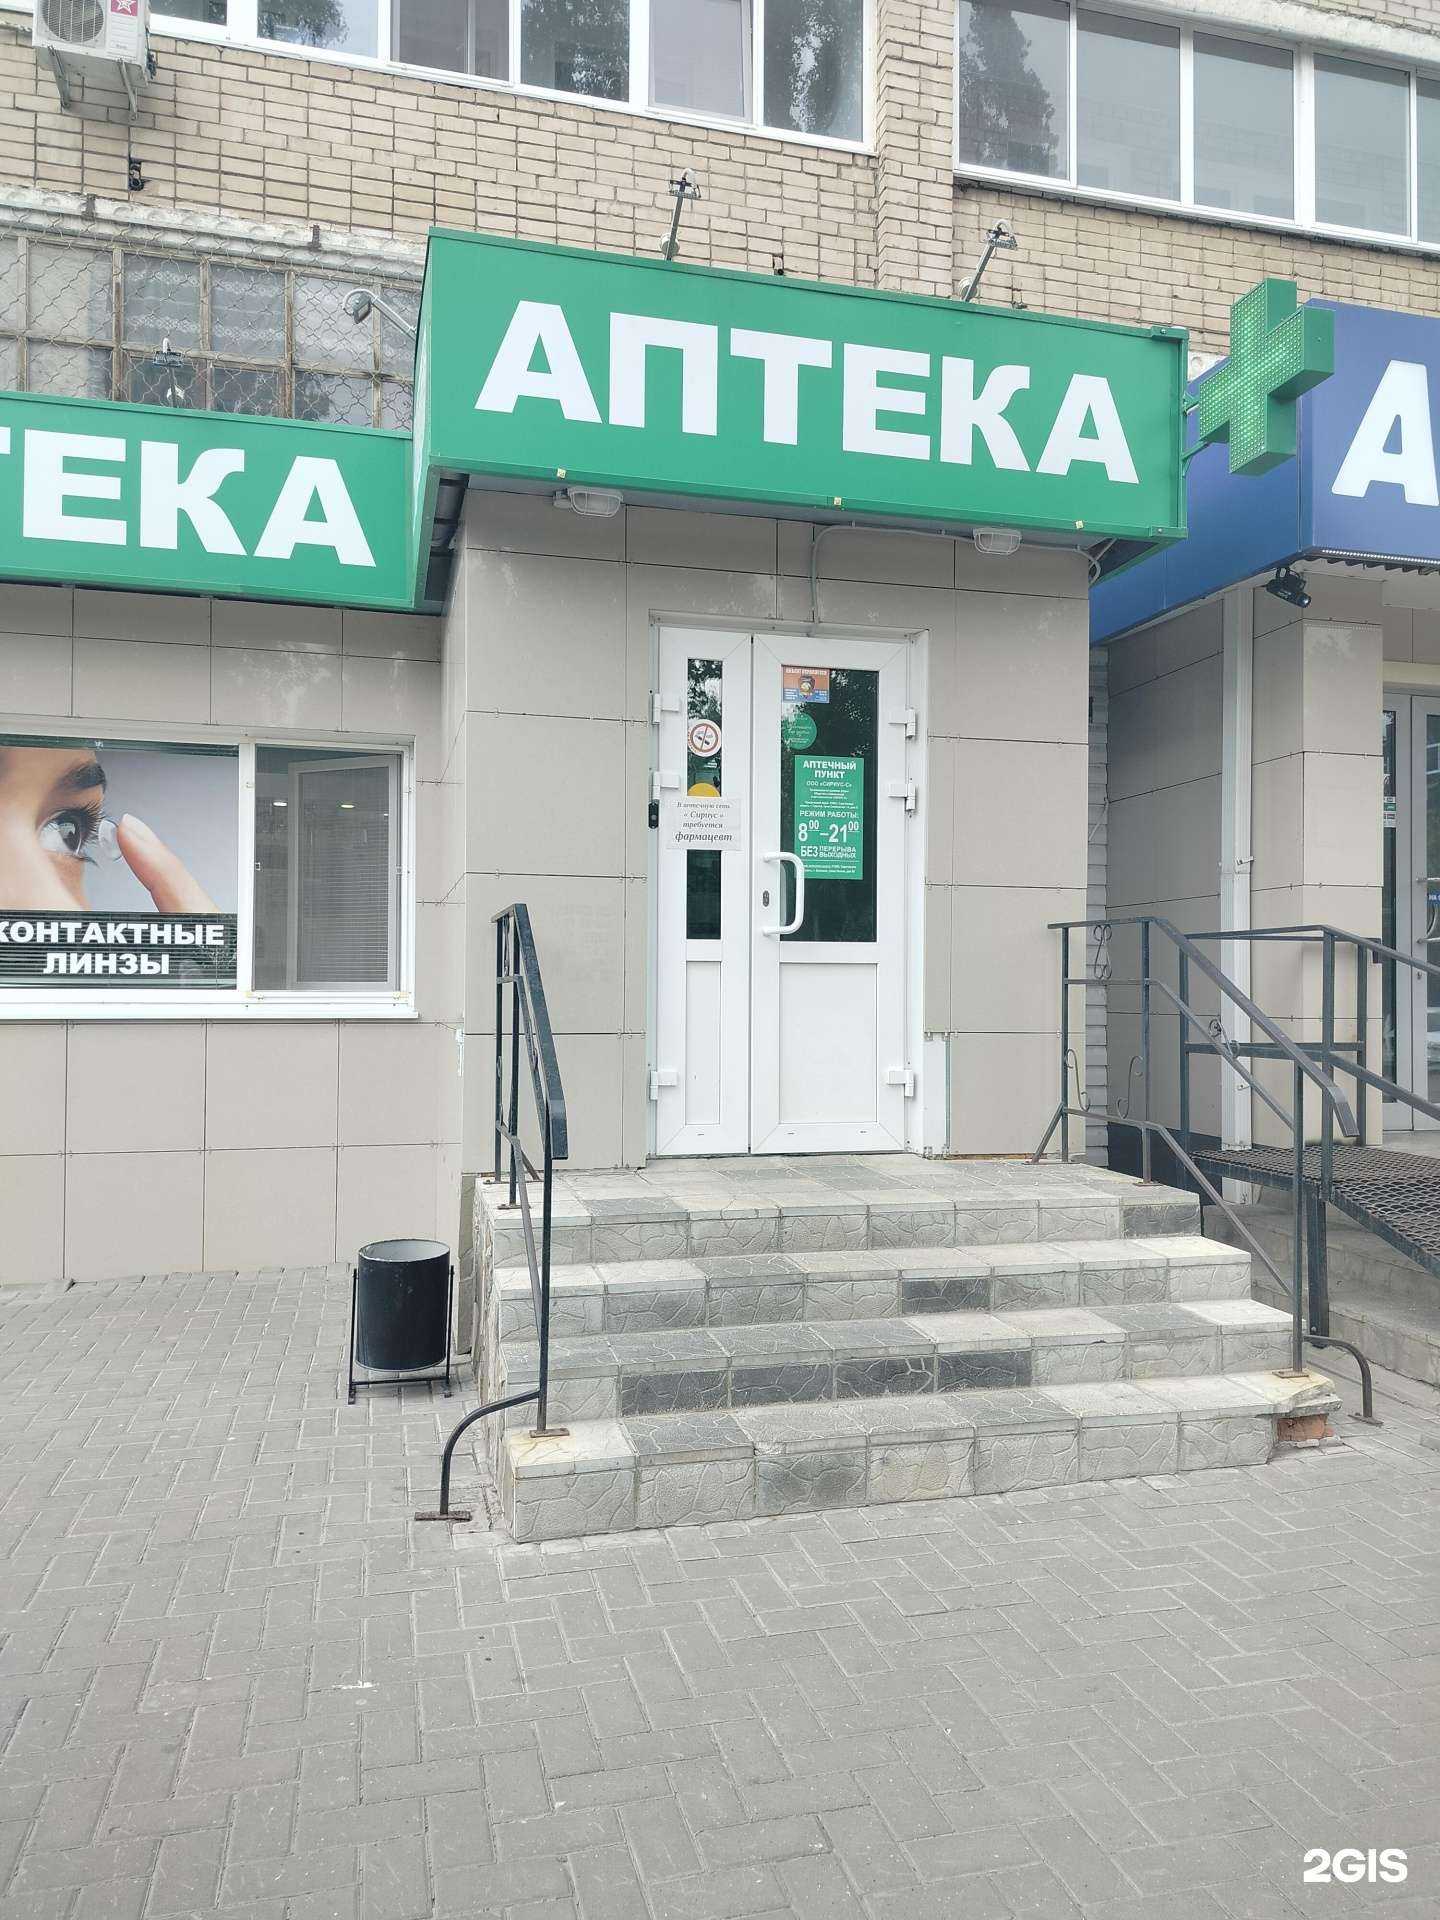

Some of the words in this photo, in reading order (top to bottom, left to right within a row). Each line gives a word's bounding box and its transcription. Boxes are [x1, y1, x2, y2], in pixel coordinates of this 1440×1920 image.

[474, 300, 1140, 485] АПТЕКА
[0, 426, 377, 568] ЕКА
[803, 760, 856, 770] АПТЕЧНЫЙ
[814, 770, 846, 779] ПУНКТ
[682, 821, 723, 829] требуется
[675, 832, 733, 842] фармацевт
[800, 845, 818, 857] БЕЗ
[43, 952, 170, 975] ЛИНЗЫ
